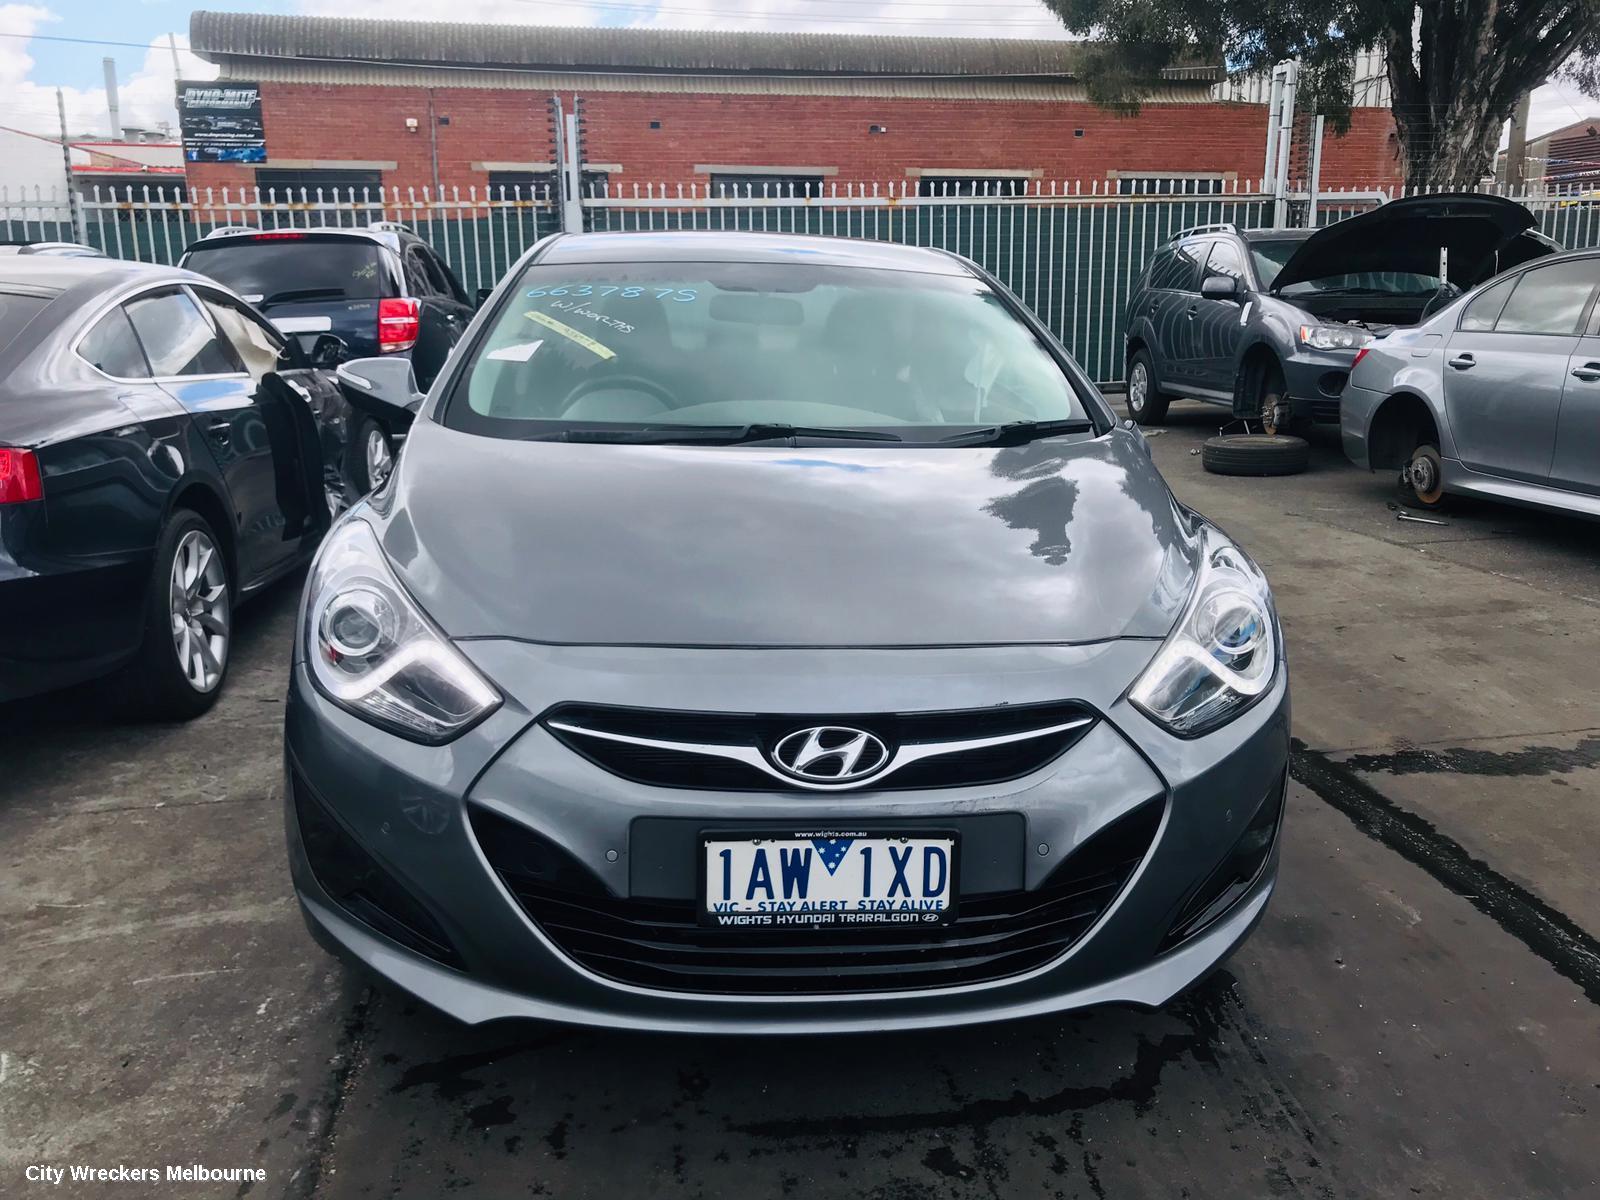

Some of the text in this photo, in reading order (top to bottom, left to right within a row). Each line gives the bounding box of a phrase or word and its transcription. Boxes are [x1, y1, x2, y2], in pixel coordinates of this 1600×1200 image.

[719, 846, 948, 901] 1AW 1XD
[713, 902, 740, 912] VIC
[757, 902, 797, 912] STAY
[800, 900, 849, 911] ALERT
[857, 900, 895, 911] STAY
[899, 899, 944, 911] ALIVE
[718, 913, 919, 926] WIGHTS HYUNDAI TRARALGON
